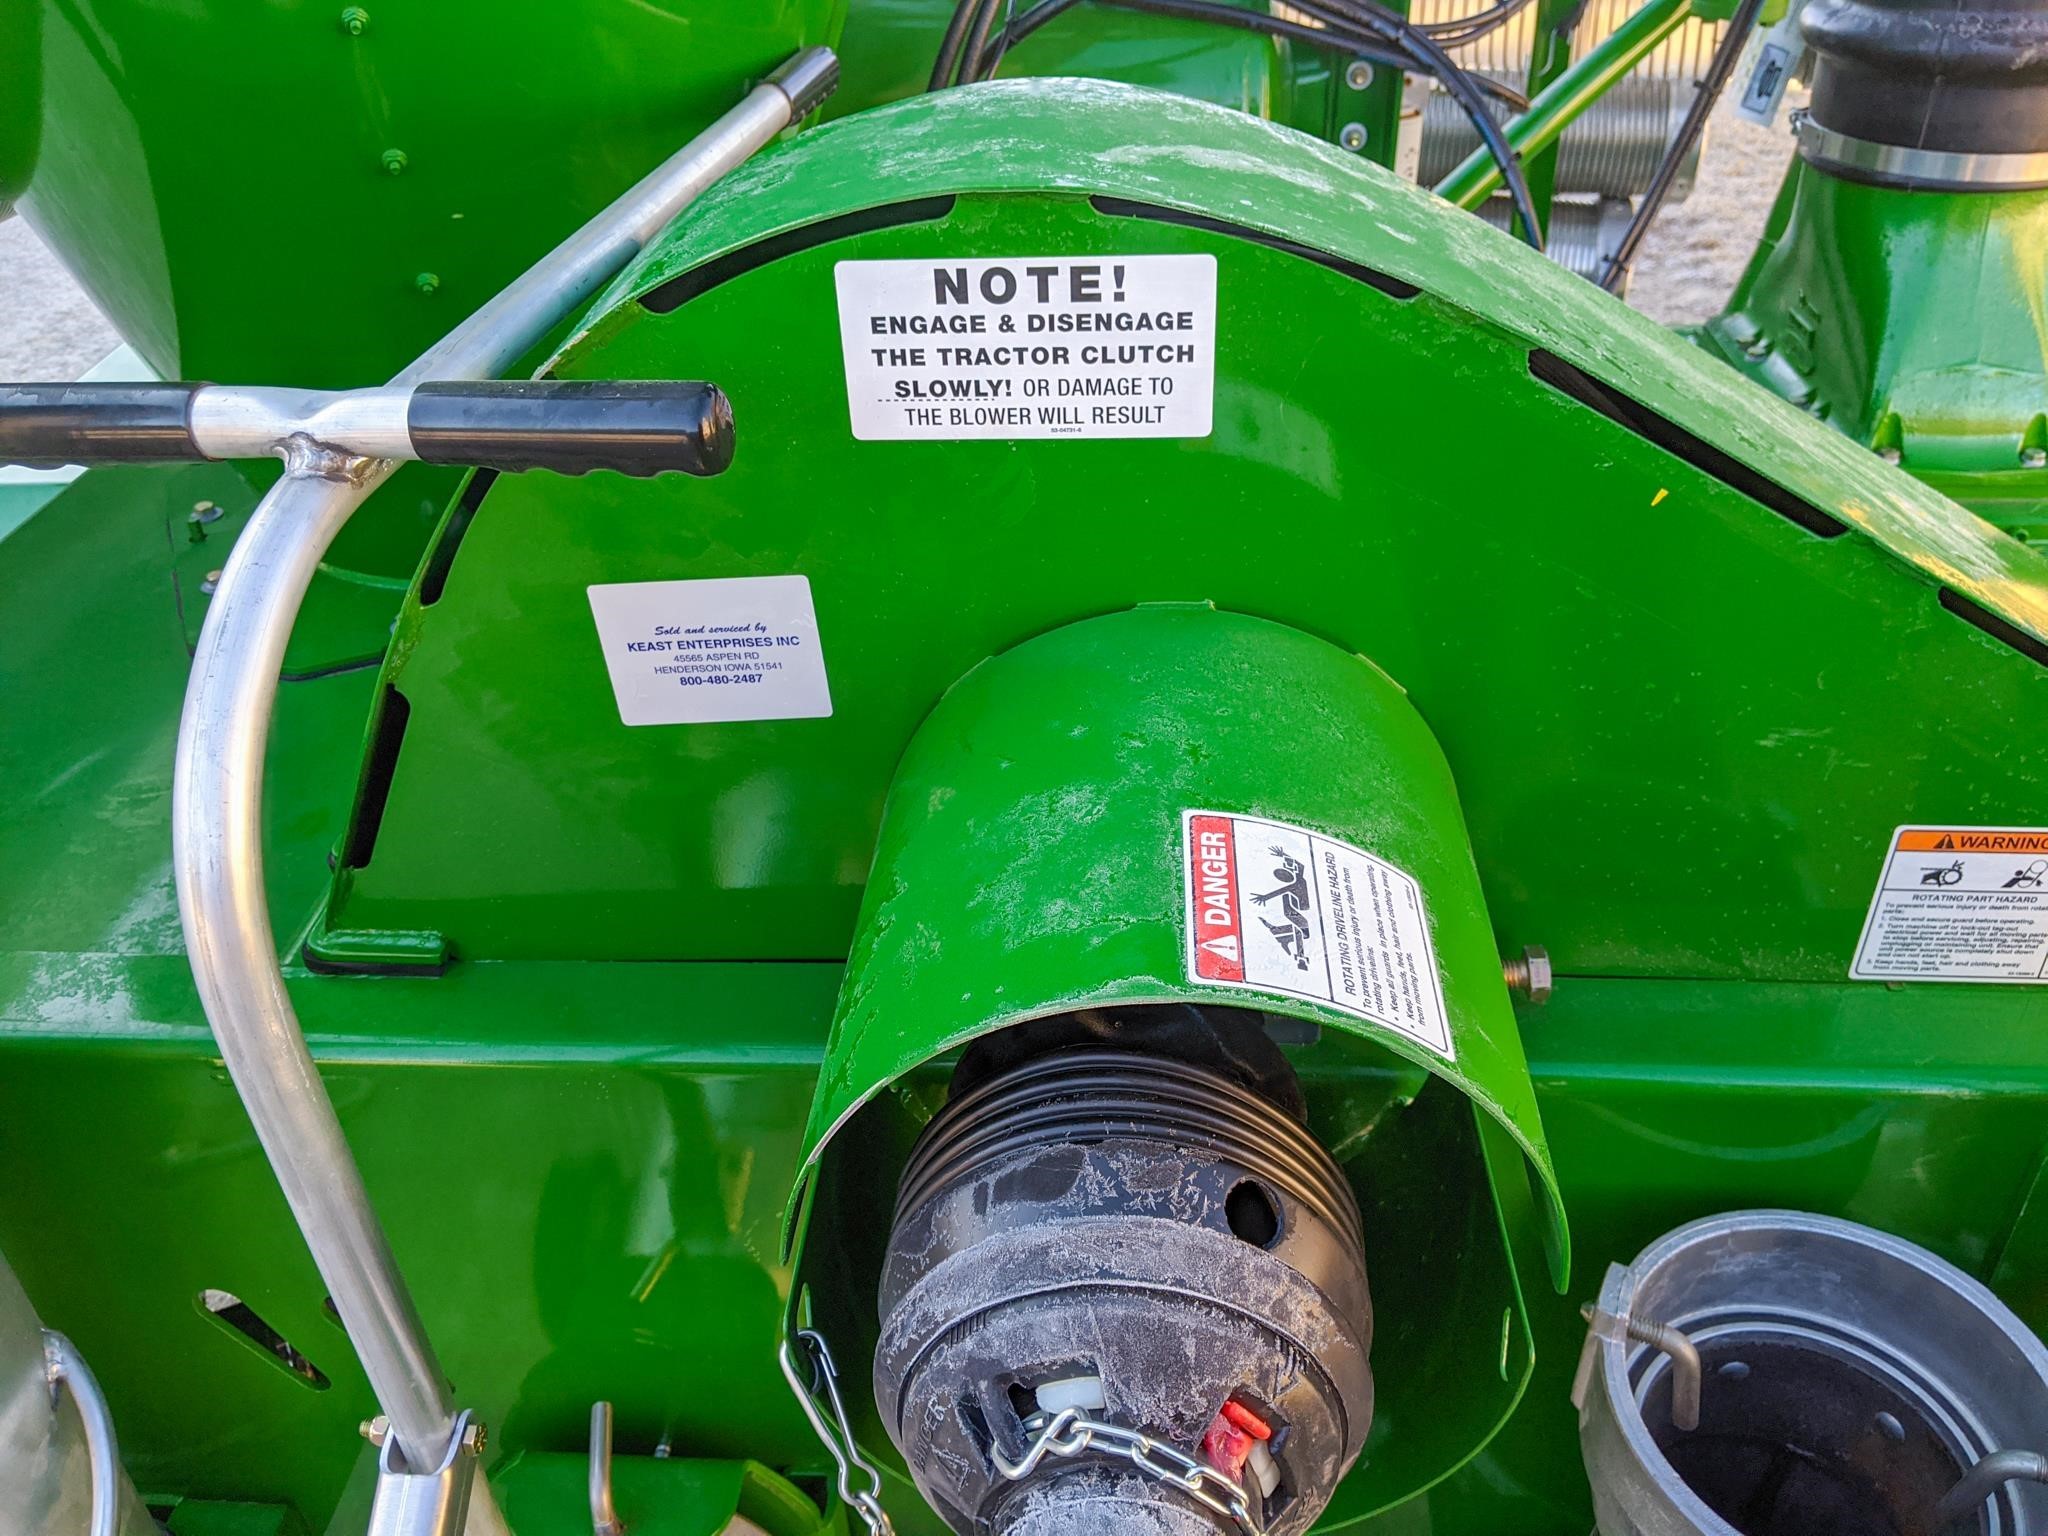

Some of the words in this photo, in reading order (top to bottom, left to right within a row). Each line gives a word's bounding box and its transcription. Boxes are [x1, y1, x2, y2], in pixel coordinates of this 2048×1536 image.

[933, 265, 1125, 305] NOTE!
[870, 314, 986, 334] ENGAGE
[998, 315, 1016, 333] &
[1027, 311, 1194, 333] DISENGAGE
[871, 348, 926, 367] THE
[936, 345, 1070, 366] TRACTOR
[1081, 344, 1195, 365] CLUTCH
[894, 379, 1012, 399] SLOWLY!
[1023, 378, 1050, 397] OR
[1057, 377, 1143, 397] DAMAGE
[1148, 376, 1173, 396] TO
[904, 408, 943, 426] THE
[949, 407, 1032, 426] BLOWER
[1038, 406, 1084, 425] WILL
[1092, 405, 1166, 424] RESULT
[654, 625, 681, 636] Sold
[684, 625, 705, 634] and
[708, 623, 750, 633] serviced
[754, 622, 767, 633] by
[627, 641, 672, 652] KEAST
[677, 637, 773, 650] ENTERPRISES
[776, 635, 800, 646] INC
[673, 654, 703, 663] 45565
[706, 652, 742, 662] ASPEN
[744, 651, 760, 660] RD
[654, 665, 722, 675] HENDERSON
[724, 663, 751, 672] IOWA
[754, 662, 783, 671] 51541
[680, 674, 763, 686] 800-480-2487
[1200, 832, 1232, 926] DANGER
[1325, 851, 1340, 890] HAZARD
[1343, 867, 1352, 884] from
[1381, 869, 1390, 888] away
[1344, 884, 1355, 905] death
[1384, 888, 1395, 918] clothing
[1912, 894, 1964, 902] ROTATING
[1966, 895, 1994, 903] PART
[1331, 890, 1348, 942] DRIVELINE
[1349, 906, 1356, 914] or
[1373, 898, 1382, 918] when
[1350, 916, 1361, 937] injury
[1376, 919, 1387, 941] place
[1389, 918, 1398, 935] and
[1354, 937, 1365, 965] serious
[1380, 940, 1388, 949] in
[1392, 935, 1401, 950] hair
[1338, 942, 1356, 996] ROTATING
[1382, 951, 1395, 979] guards
[1406, 952, 1417, 975] parts.
[1359, 966, 1371, 998] prevent
[1386, 978, 1395, 989] all
[1411, 975, 1422, 1006] moving
[1363, 998, 1372, 1009] To
[1372, 982, 1384, 1015] rotating
[1390, 990, 1399, 1012] Keep
[1406, 998, 1415, 1020] Keep
[1418, 1006, 1426, 1026] from
